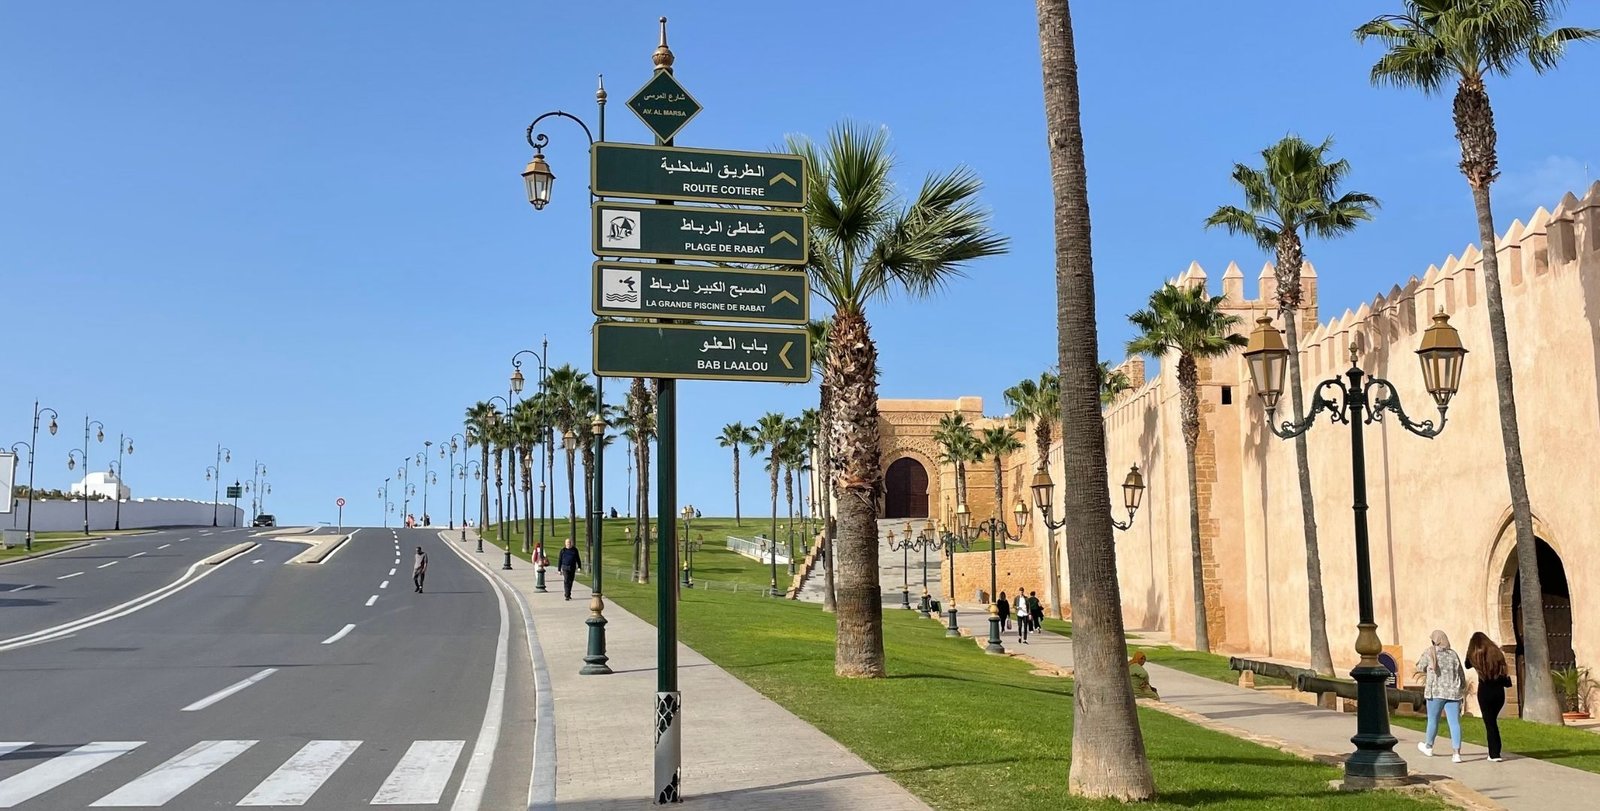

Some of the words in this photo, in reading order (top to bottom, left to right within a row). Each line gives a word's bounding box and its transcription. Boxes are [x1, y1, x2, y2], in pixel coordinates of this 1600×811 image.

[668, 93, 686, 102] شارع
[660, 157, 713, 174] الساحلية
[718, 163, 765, 178] الطريق
[683, 184, 718, 193] ROUTE
[721, 186, 765, 196] COTIERE
[680, 218, 722, 235] الرباط
[727, 220, 765, 236] شاطئ
[685, 243, 717, 252] PLAGE
[719, 244, 731, 252] DE
[734, 245, 765, 254] RABAT
[650, 277, 689, 292] للرباط
[693, 281, 726, 294] الكبير
[729, 283, 766, 297] المسبح
[694, 302, 726, 310] PISCINE
[699, 336, 736, 352] العلو
[742, 338, 768, 354] باب
[697, 360, 720, 369] BAB
[724, 361, 768, 371] LAALOU
